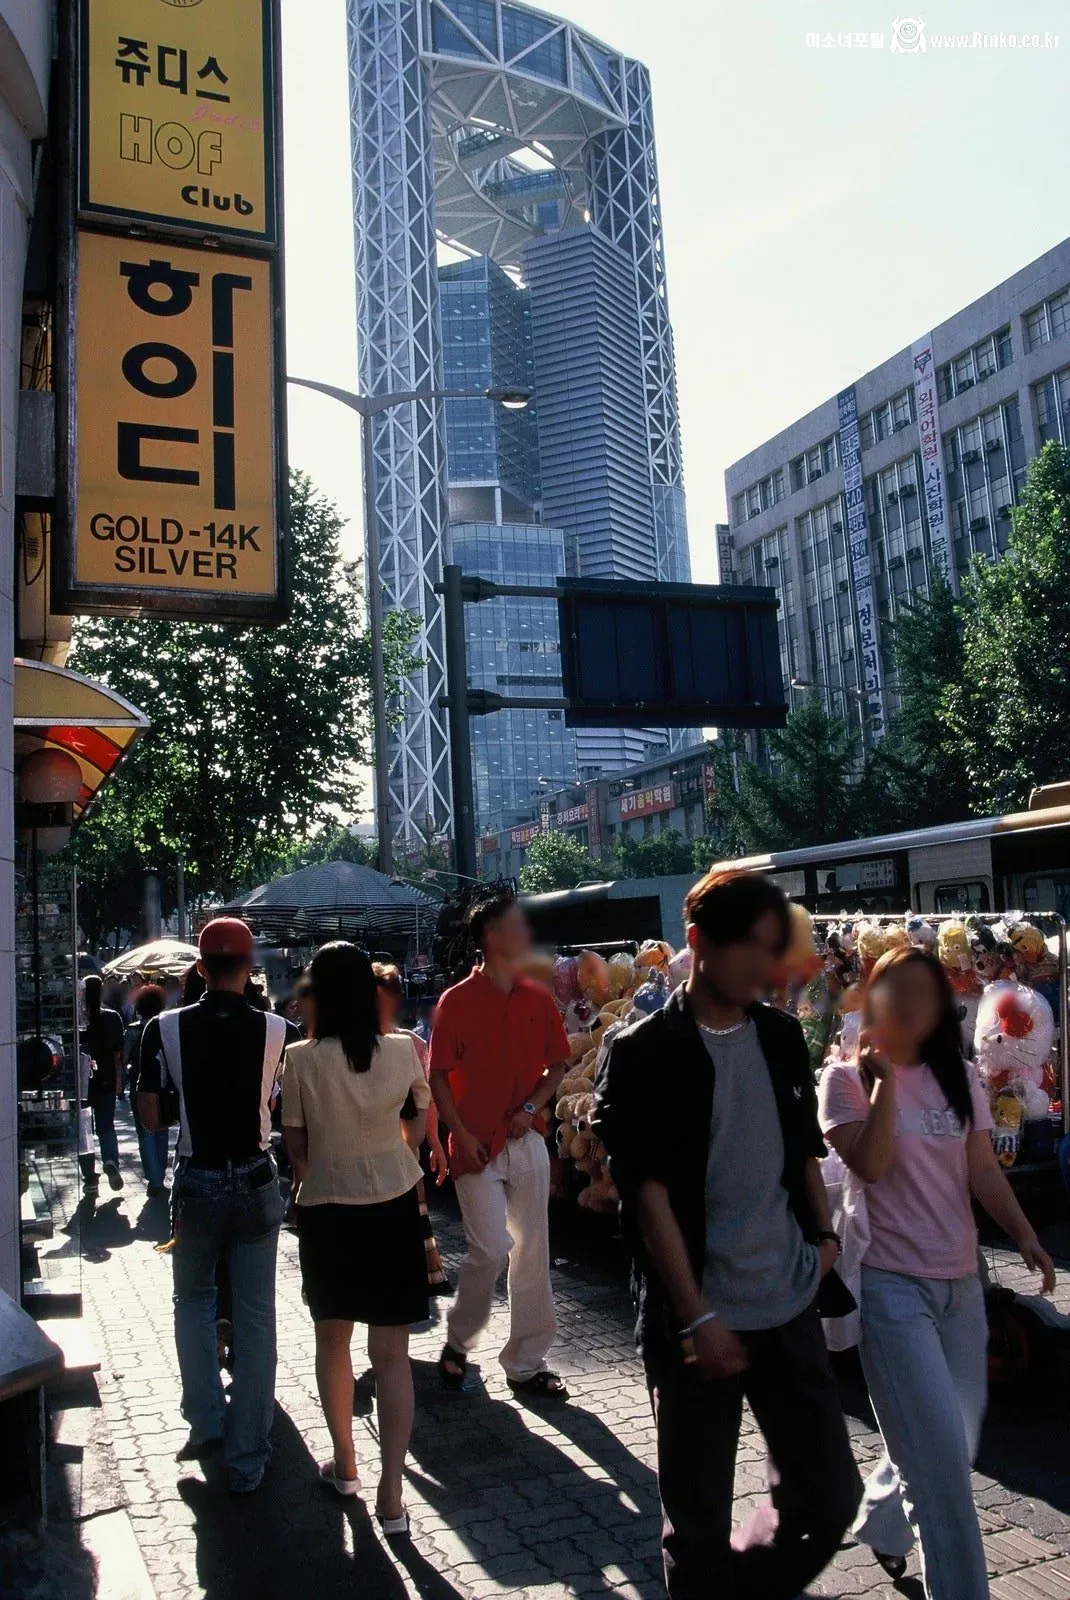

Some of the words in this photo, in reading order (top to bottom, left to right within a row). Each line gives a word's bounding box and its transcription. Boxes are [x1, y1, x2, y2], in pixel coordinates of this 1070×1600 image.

[115, 36, 230, 103] 쥬디스
[120, 113, 222, 176] HOF
[181, 185, 254, 216] Club
[117, 259, 252, 511] 하이디
[846, 488, 862, 508] CAD
[90, 513, 262, 552] GOLD-14K
[115, 545, 237, 579] SILVER
[557, 806, 580, 825] 중화요리
[621, 785, 671, 813] 세기음악학원
